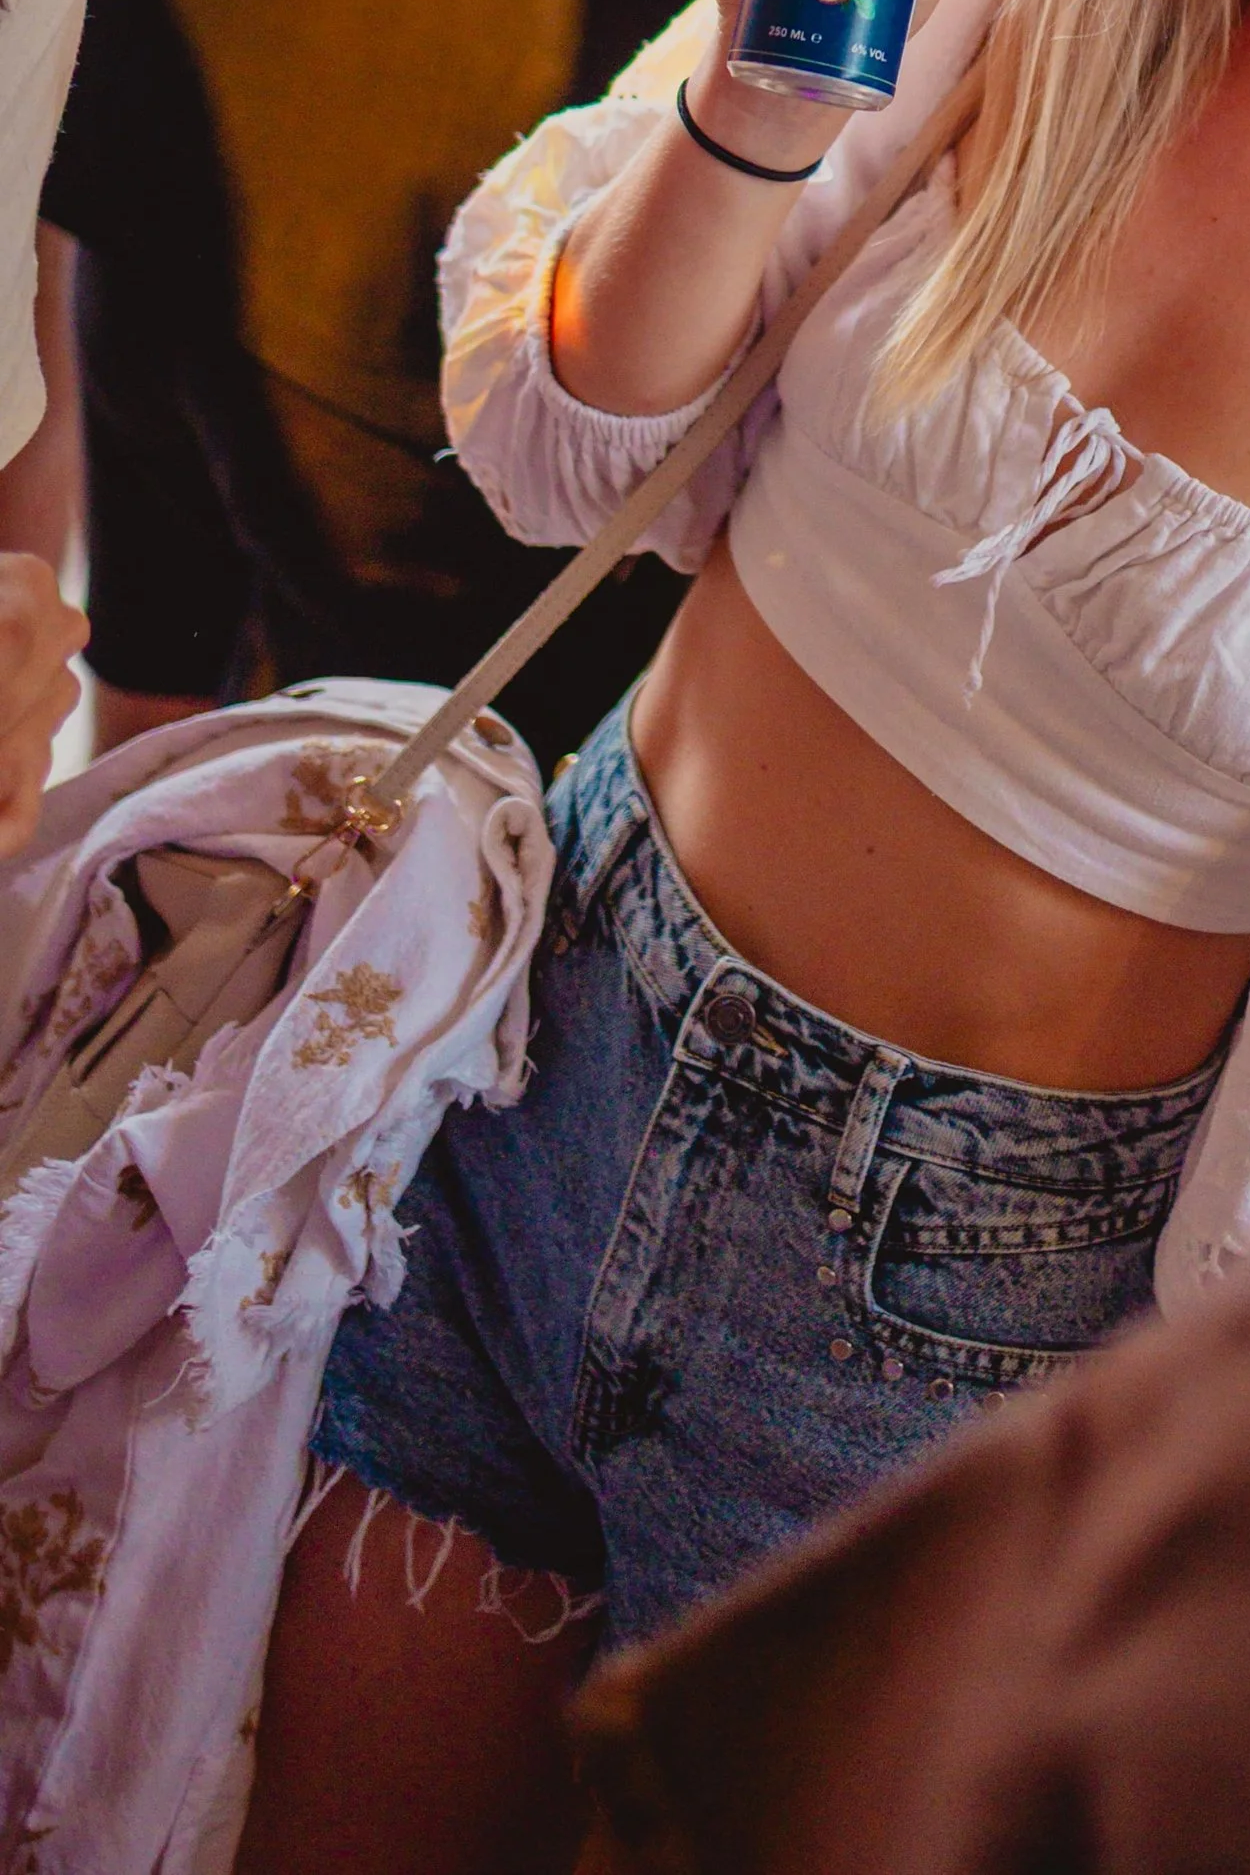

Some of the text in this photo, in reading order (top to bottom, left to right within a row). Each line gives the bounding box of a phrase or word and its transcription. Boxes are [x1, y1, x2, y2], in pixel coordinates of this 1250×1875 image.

[768, 25, 788, 38] 250
[790, 29, 806, 41] ML
[851, 43, 867, 56] 6%
